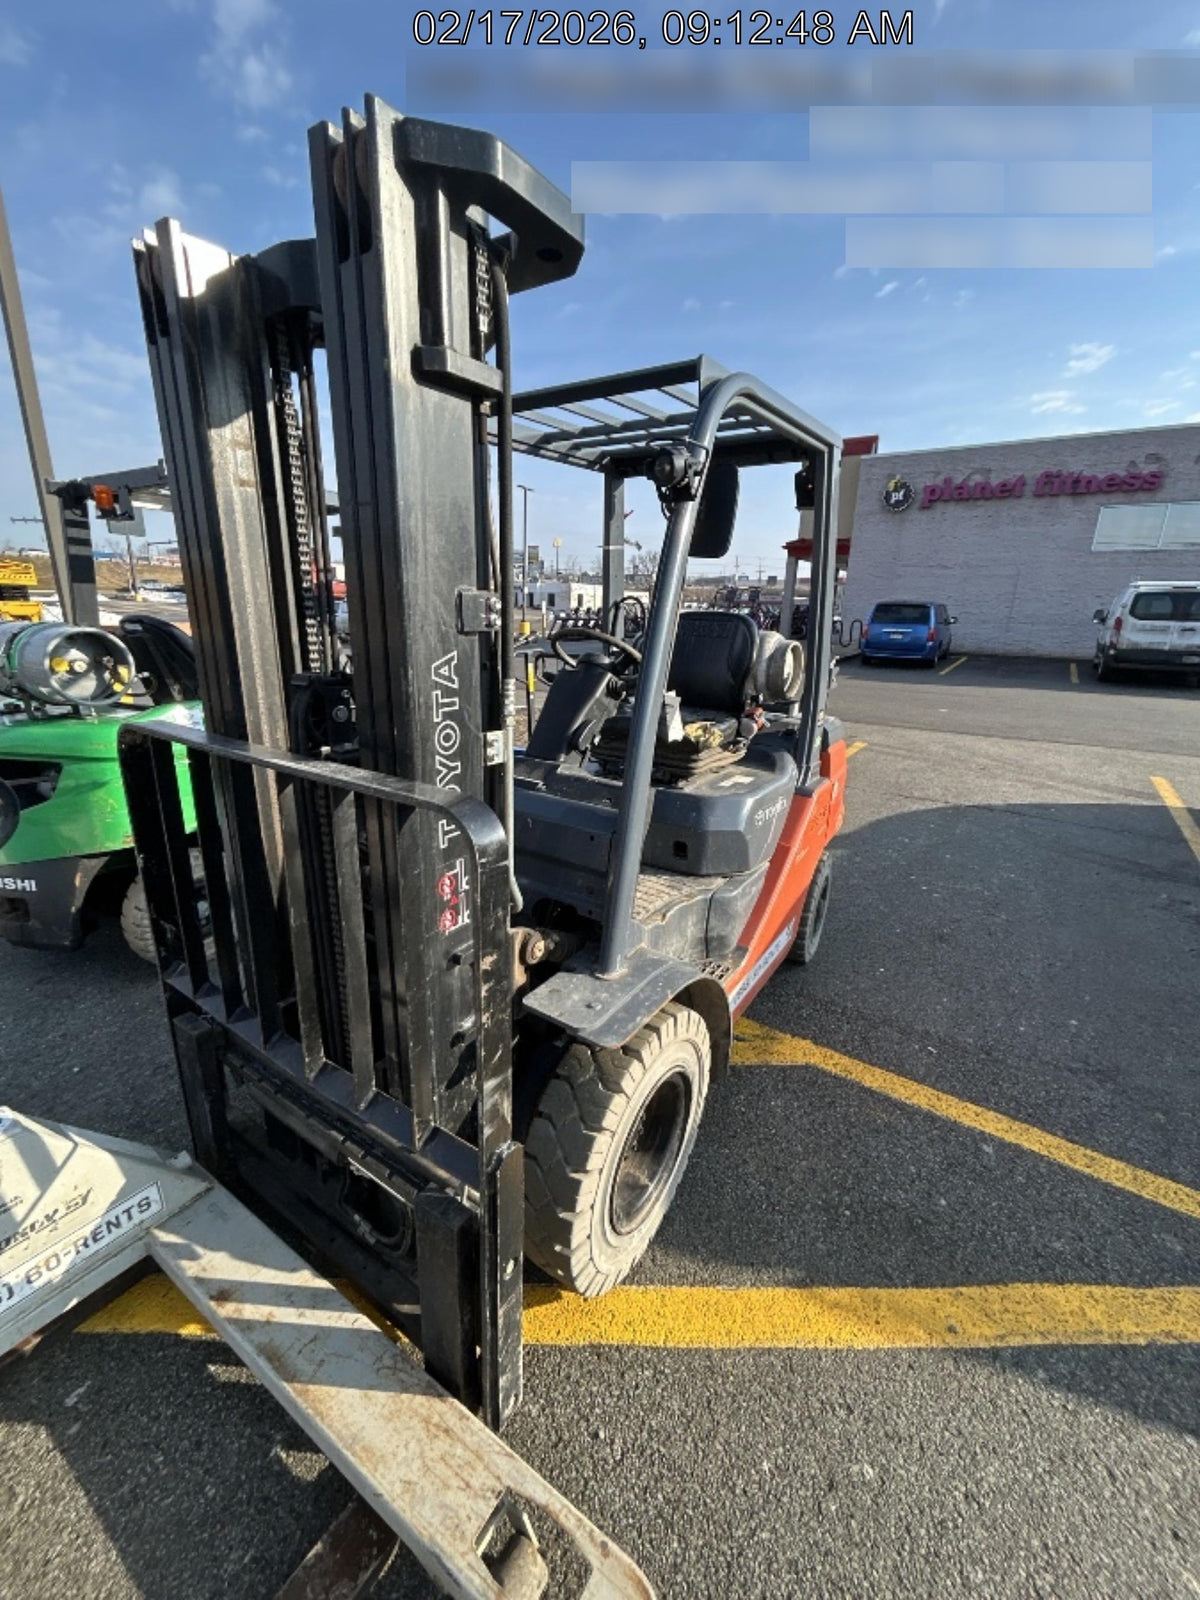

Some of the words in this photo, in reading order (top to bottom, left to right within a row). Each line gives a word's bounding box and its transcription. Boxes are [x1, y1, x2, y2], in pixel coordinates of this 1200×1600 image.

[920, 476, 1025, 509] planet
[1033, 470, 1164, 498] fitness
[432, 650, 461, 849] TYOTA
